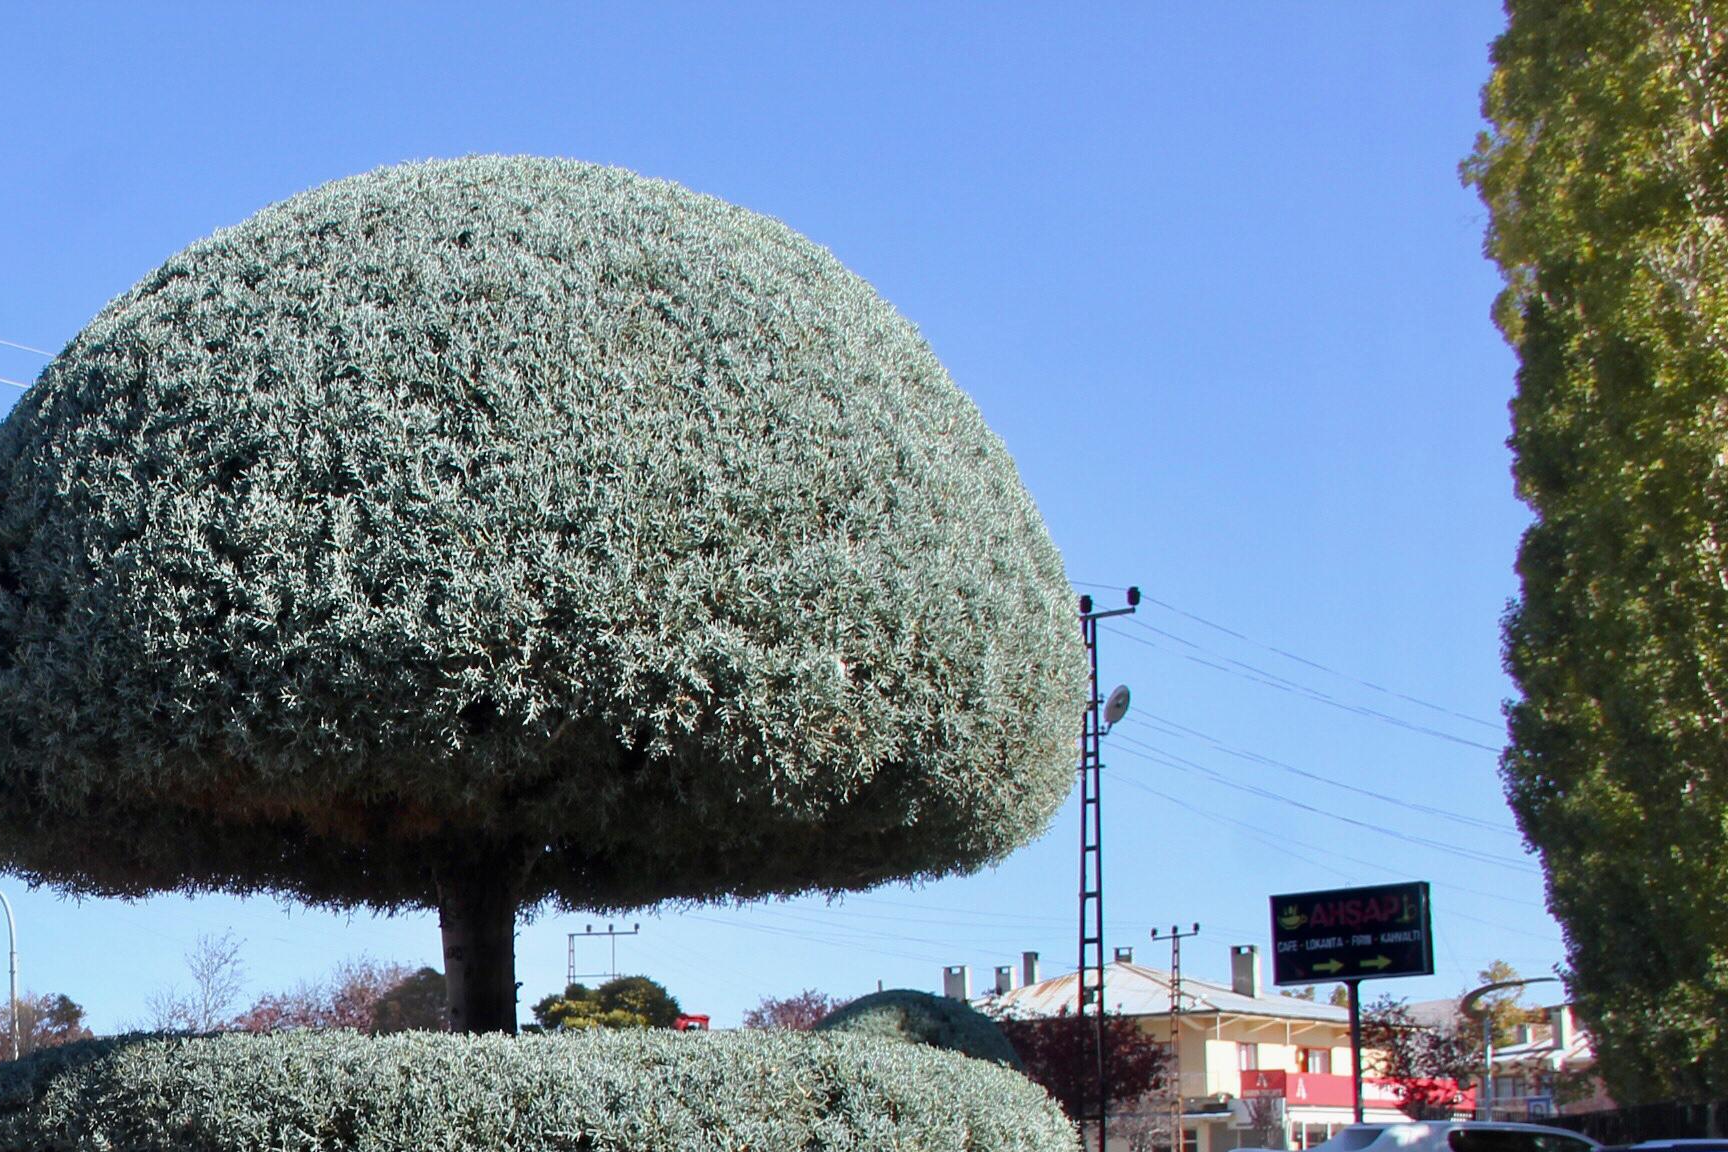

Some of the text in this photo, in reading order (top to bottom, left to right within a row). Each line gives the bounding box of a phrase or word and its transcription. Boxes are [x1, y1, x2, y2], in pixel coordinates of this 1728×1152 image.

[1277, 940, 1299, 953] CAFE
[1305, 936, 1344, 950] LOKANTA
[1380, 929, 1422, 944] KAHVALTI
